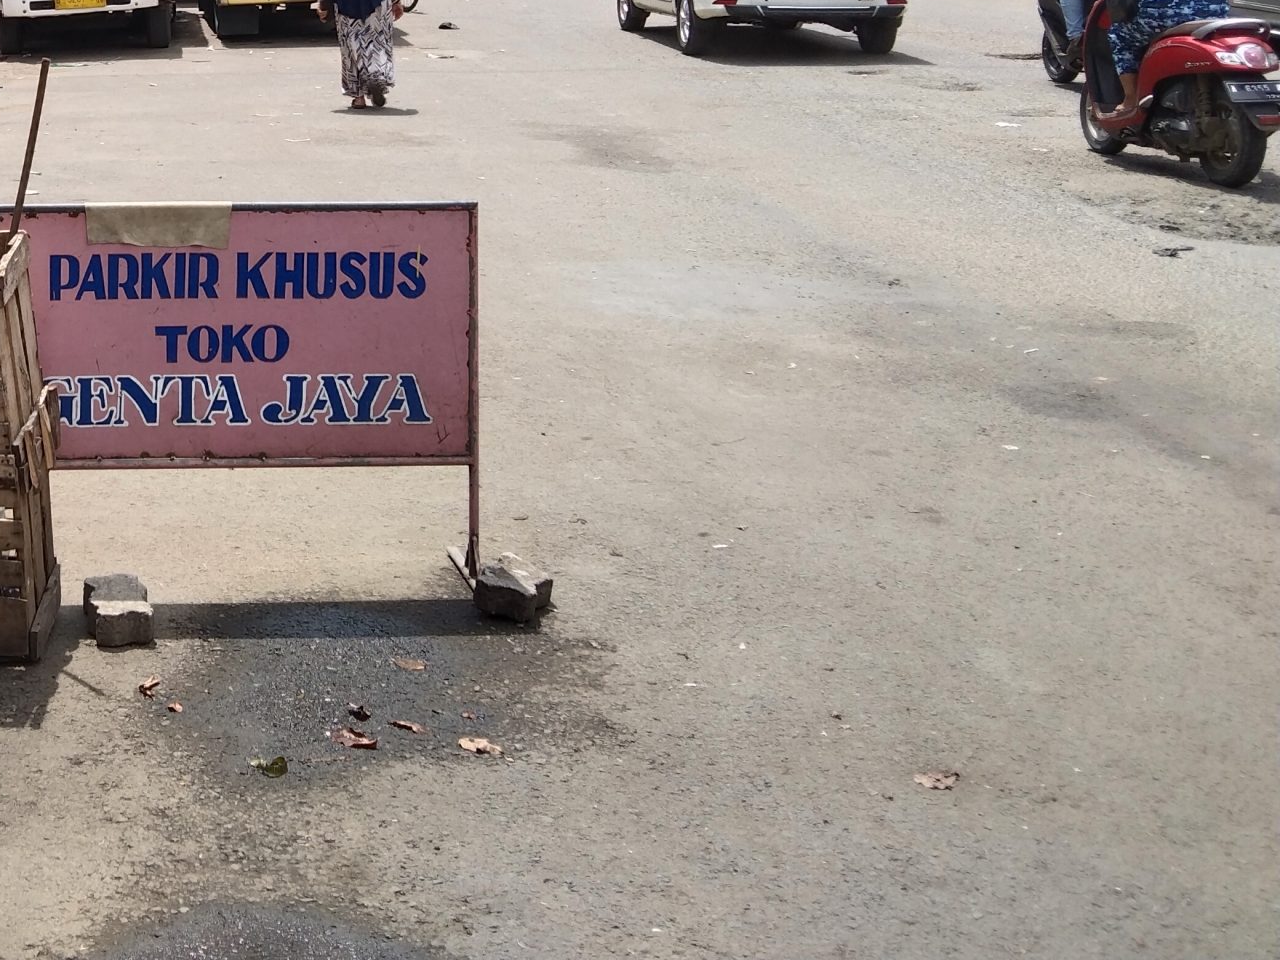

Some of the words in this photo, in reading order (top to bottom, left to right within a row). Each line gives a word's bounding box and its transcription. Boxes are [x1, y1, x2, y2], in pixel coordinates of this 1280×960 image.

[49, 252, 220, 301] PARKIR
[235, 251, 429, 300] KHUSUS
[154, 324, 290, 364] TOKO
[43, 374, 252, 427] GENTA
[260, 374, 433, 426] JAYA
